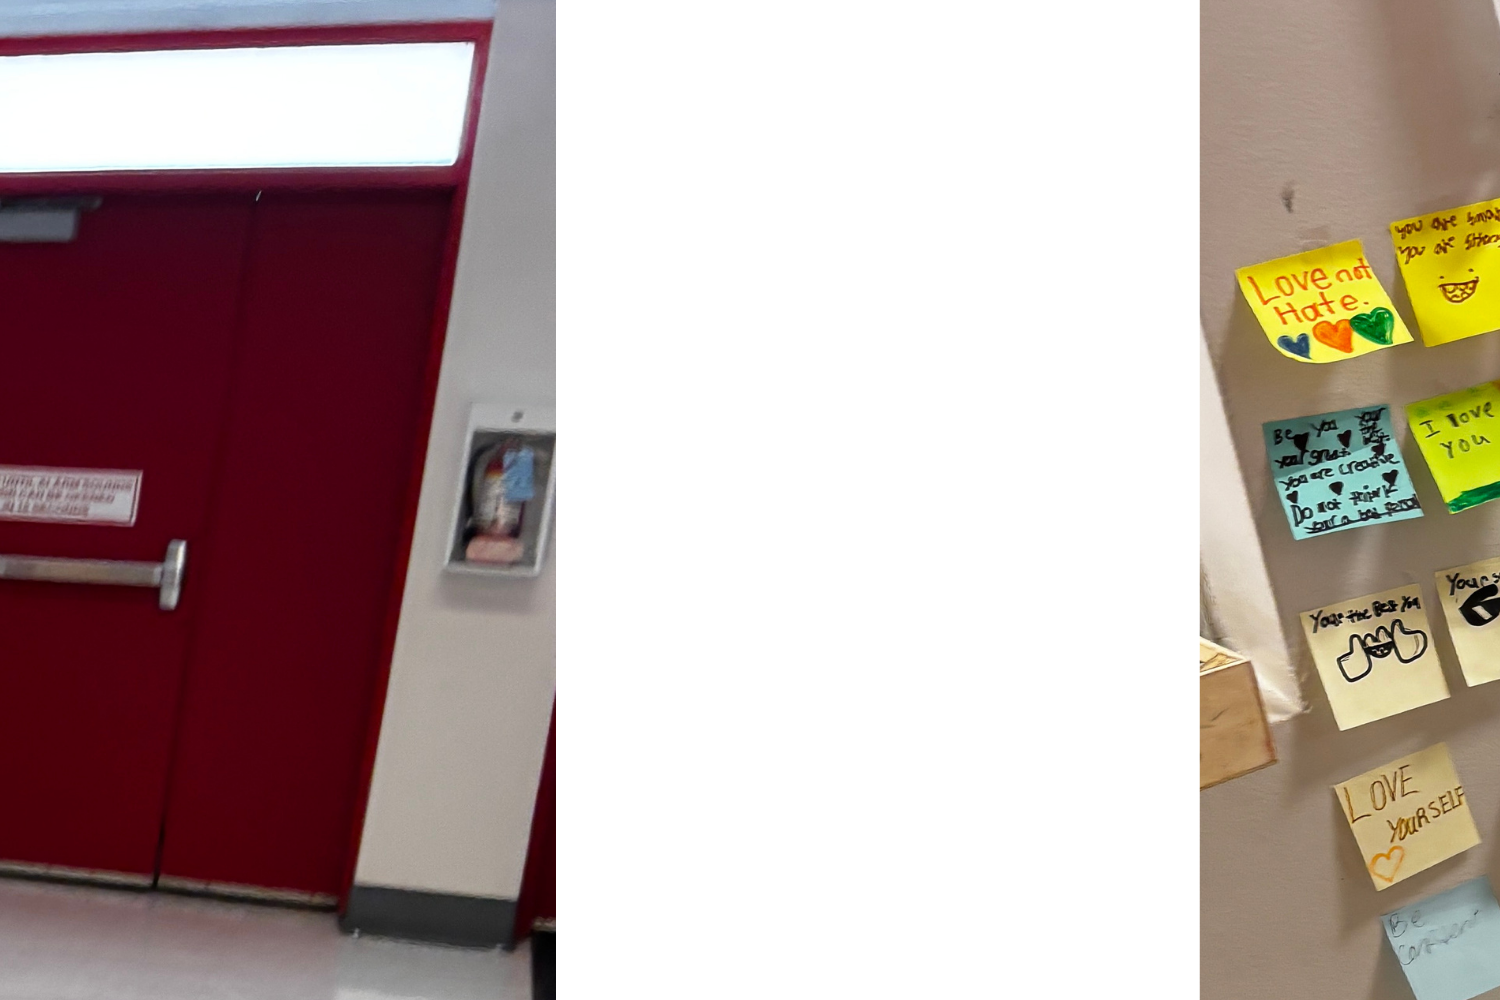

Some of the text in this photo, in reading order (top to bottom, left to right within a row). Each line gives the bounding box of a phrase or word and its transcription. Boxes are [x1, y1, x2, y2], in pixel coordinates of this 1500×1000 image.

[1247, 257, 1373, 306] Love not
[1419, 419, 1441, 438] I
[1446, 401, 1495, 428] love
[1291, 503, 1314, 527] Do
[1343, 764, 1420, 824] LOVE
[1386, 785, 1466, 843] YOURSELF
